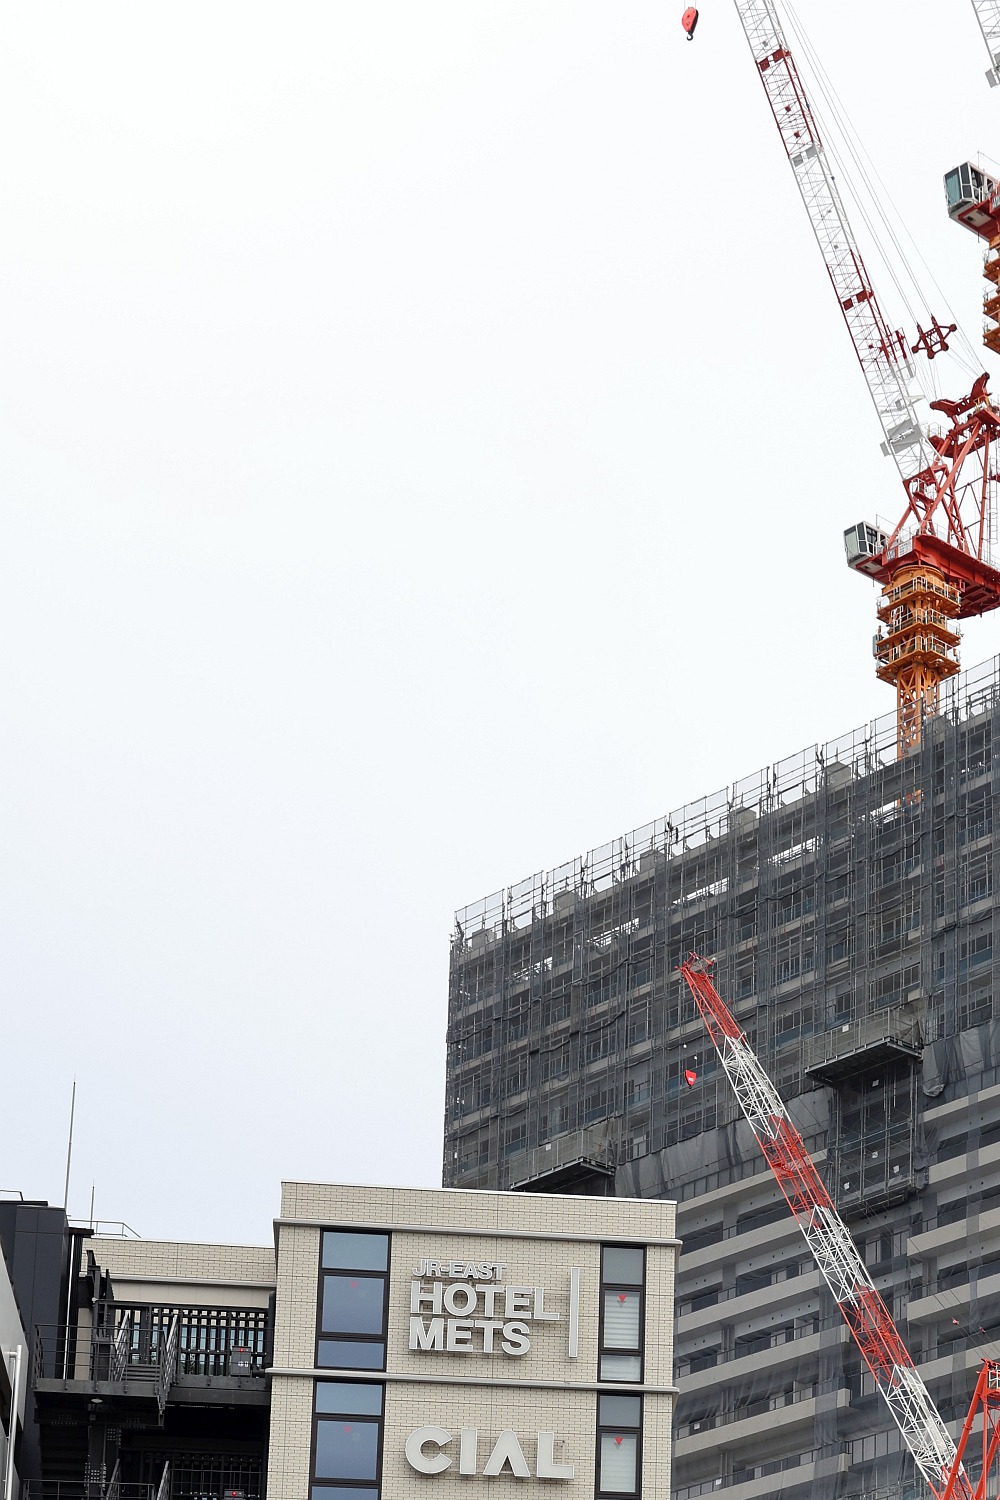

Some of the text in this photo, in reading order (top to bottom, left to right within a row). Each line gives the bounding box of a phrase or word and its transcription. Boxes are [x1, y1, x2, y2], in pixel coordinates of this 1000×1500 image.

[412, 1258, 507, 1281] JR-EAST
[410, 1280, 560, 1321] HOTEL
[408, 1316, 531, 1356] METS
[404, 1425, 575, 1479] CIAL
